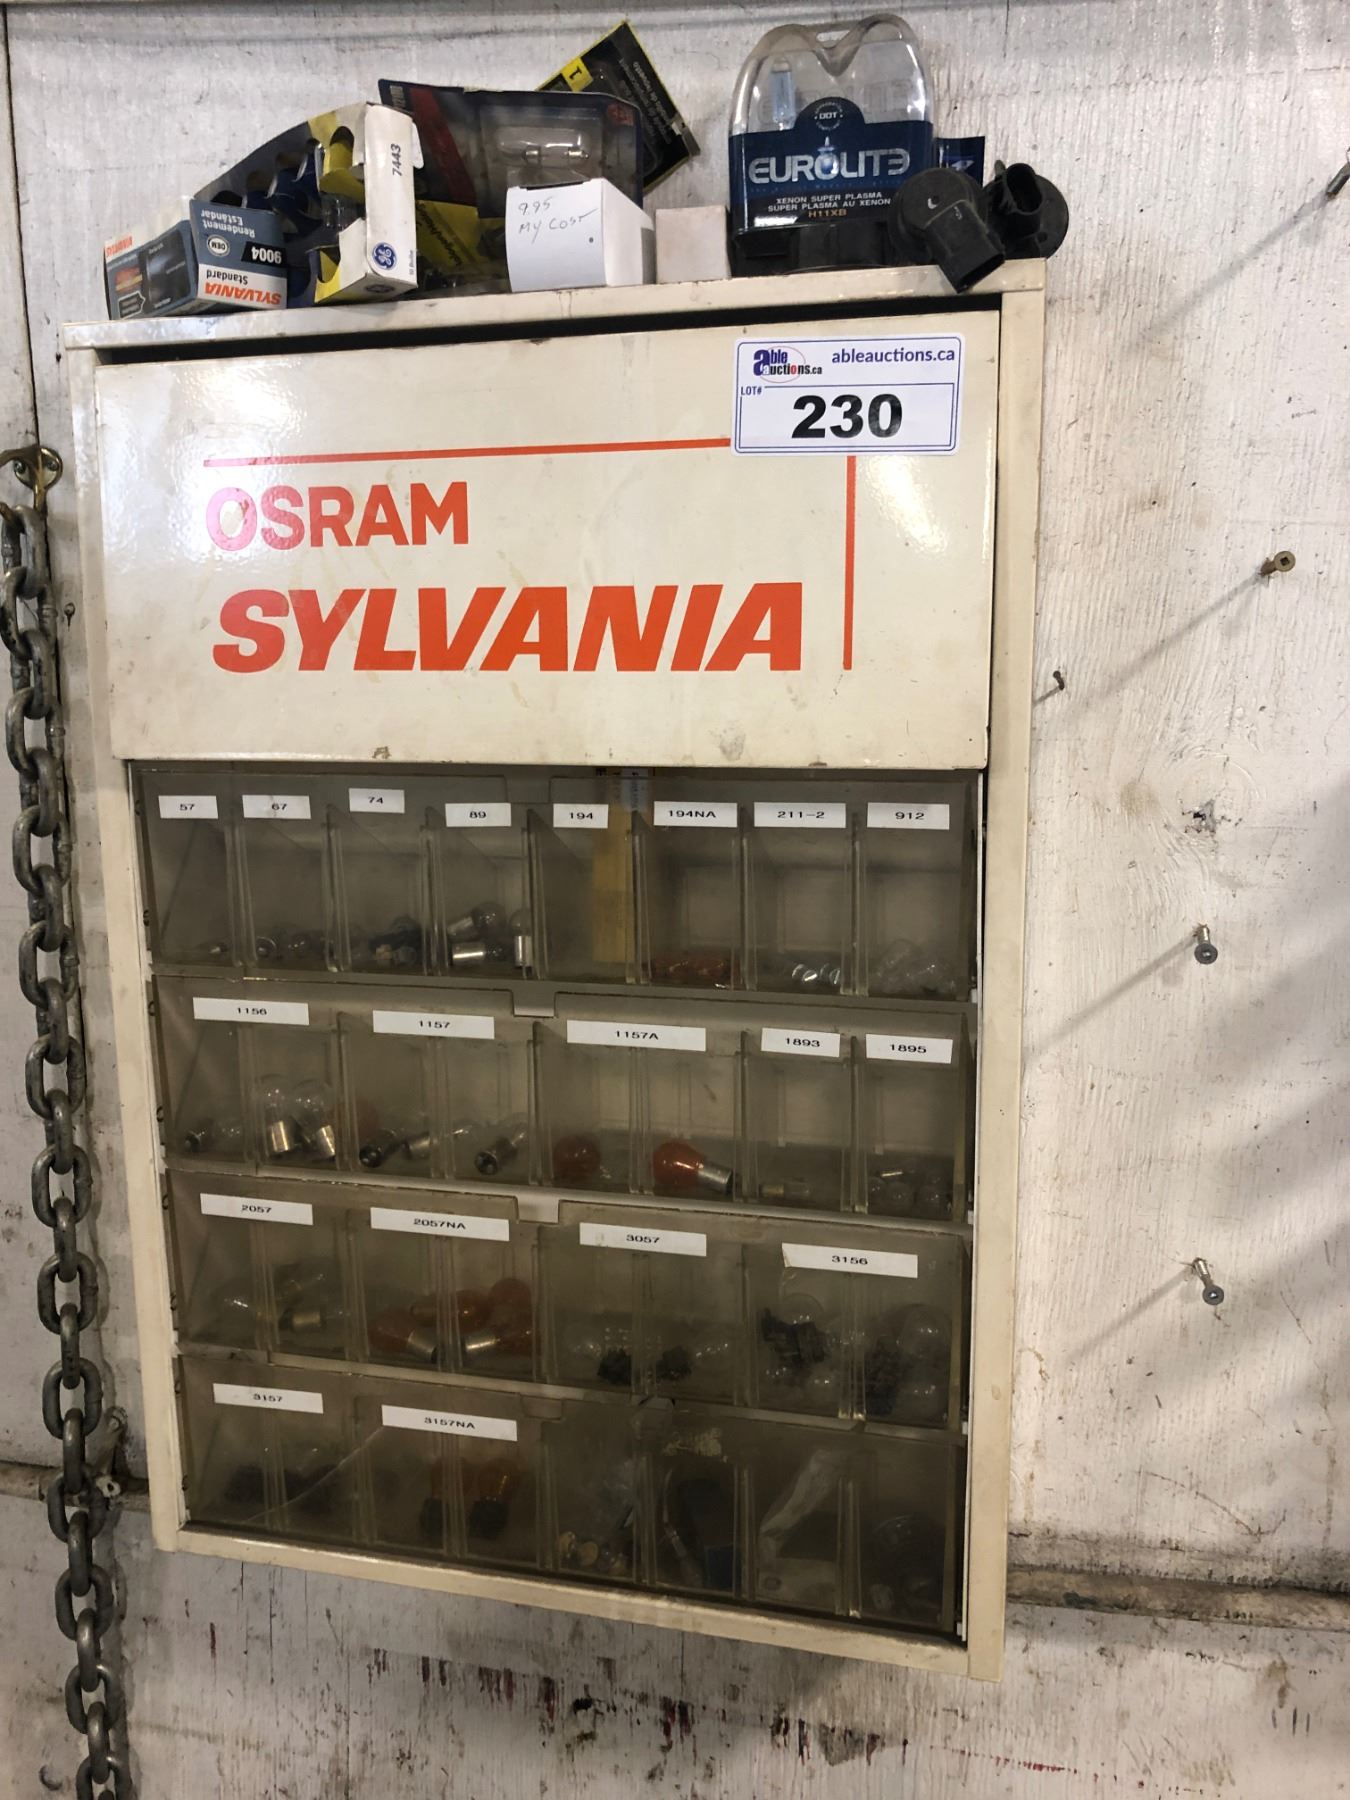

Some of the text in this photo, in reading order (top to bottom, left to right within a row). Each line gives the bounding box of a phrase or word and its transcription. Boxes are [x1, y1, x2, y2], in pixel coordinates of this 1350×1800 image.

[391, 143, 402, 177] 7443
[776, 191, 882, 205] XENON SUPER PLASMA
[768, 198, 891, 212] SUPER PLASMA AU XENON
[203, 219, 256, 238] Rendement
[251, 246, 282, 264] 9004
[206, 269, 248, 285] Standard
[205, 282, 282, 305] SYLVANIA
[832, 347, 955, 364] ableauctions.ca
[740, 386, 762, 396] LOT#
[791, 393, 903, 438] 230
[205, 481, 469, 551] OSRAM
[212, 582, 803, 673] SYLVANIA
[179, 803, 195, 811] 57
[271, 803, 287, 811] 67
[468, 811, 487, 819] 89
[569, 811, 594, 820] 194
[668, 810, 717, 818] 194NA
[777, 810, 825, 819] 211-2
[894, 811, 925, 820] 912
[236, 1007, 267, 1016] 1156
[418, 1020, 450, 1029] 1157
[615, 1030, 659, 1041] 1157A
[785, 1037, 820, 1048] 1893
[889, 1043, 927, 1054] 1895
[241, 1204, 272, 1214] 2057
[413, 1218, 466, 1230] 2057NA
[626, 1234, 660, 1244] 3057
[831, 1255, 868, 1265] 3156
[253, 1393, 283, 1403] 3157
[424, 1416, 476, 1429] 3157NA
